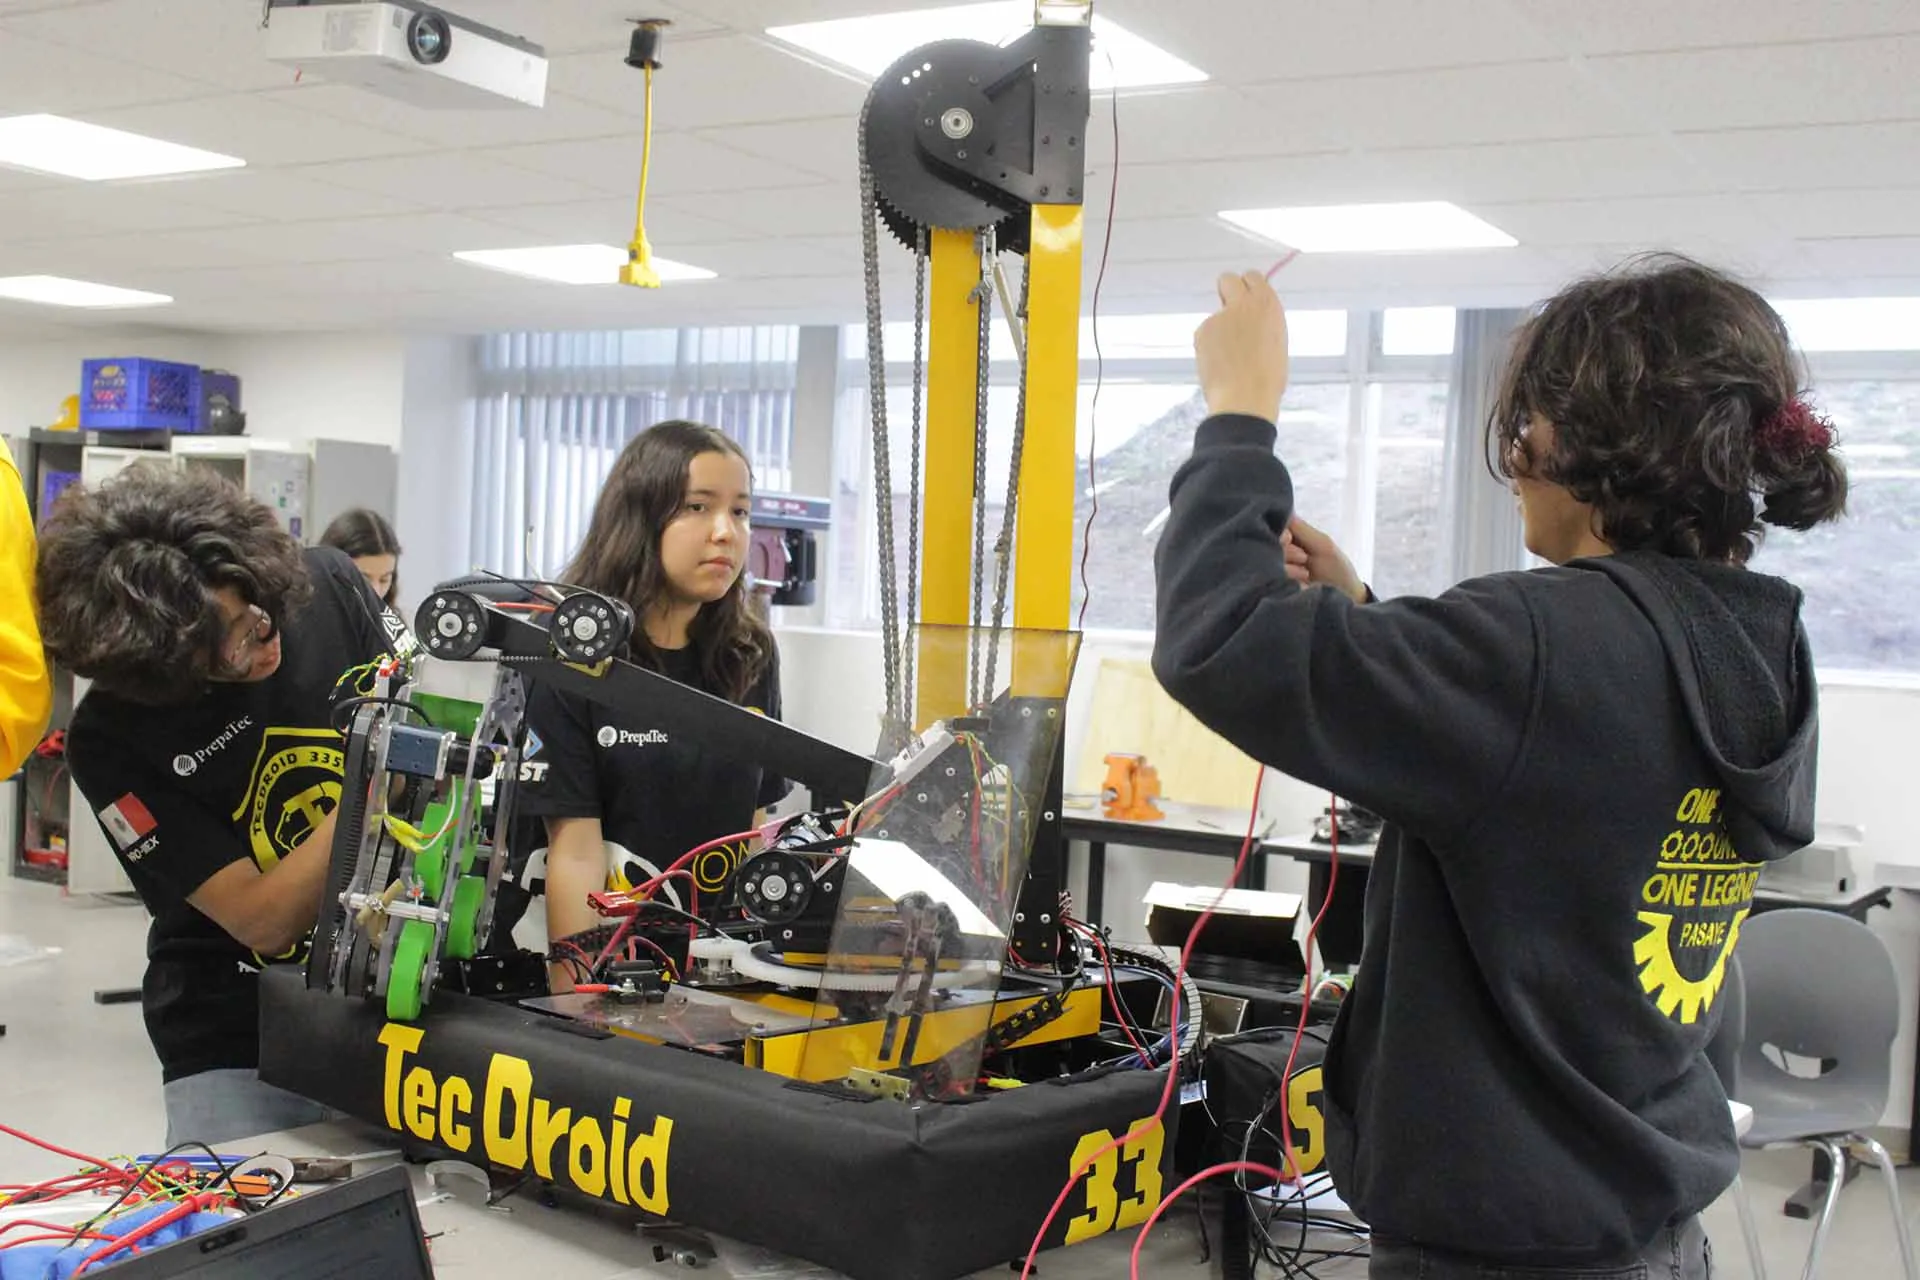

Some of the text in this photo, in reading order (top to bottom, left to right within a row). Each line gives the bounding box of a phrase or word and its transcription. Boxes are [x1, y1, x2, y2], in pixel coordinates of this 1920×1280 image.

[195, 715, 253, 763] PrepaTec
[619, 729, 668, 747] PrepaTec
[253, 752, 298, 836] TECDROID
[1676, 788, 1720, 824] ONE
[1641, 871, 1759, 906] ONE LEGEND
[1679, 921, 1727, 947] PASAYE
[1064, 1115, 1166, 1247] 33
